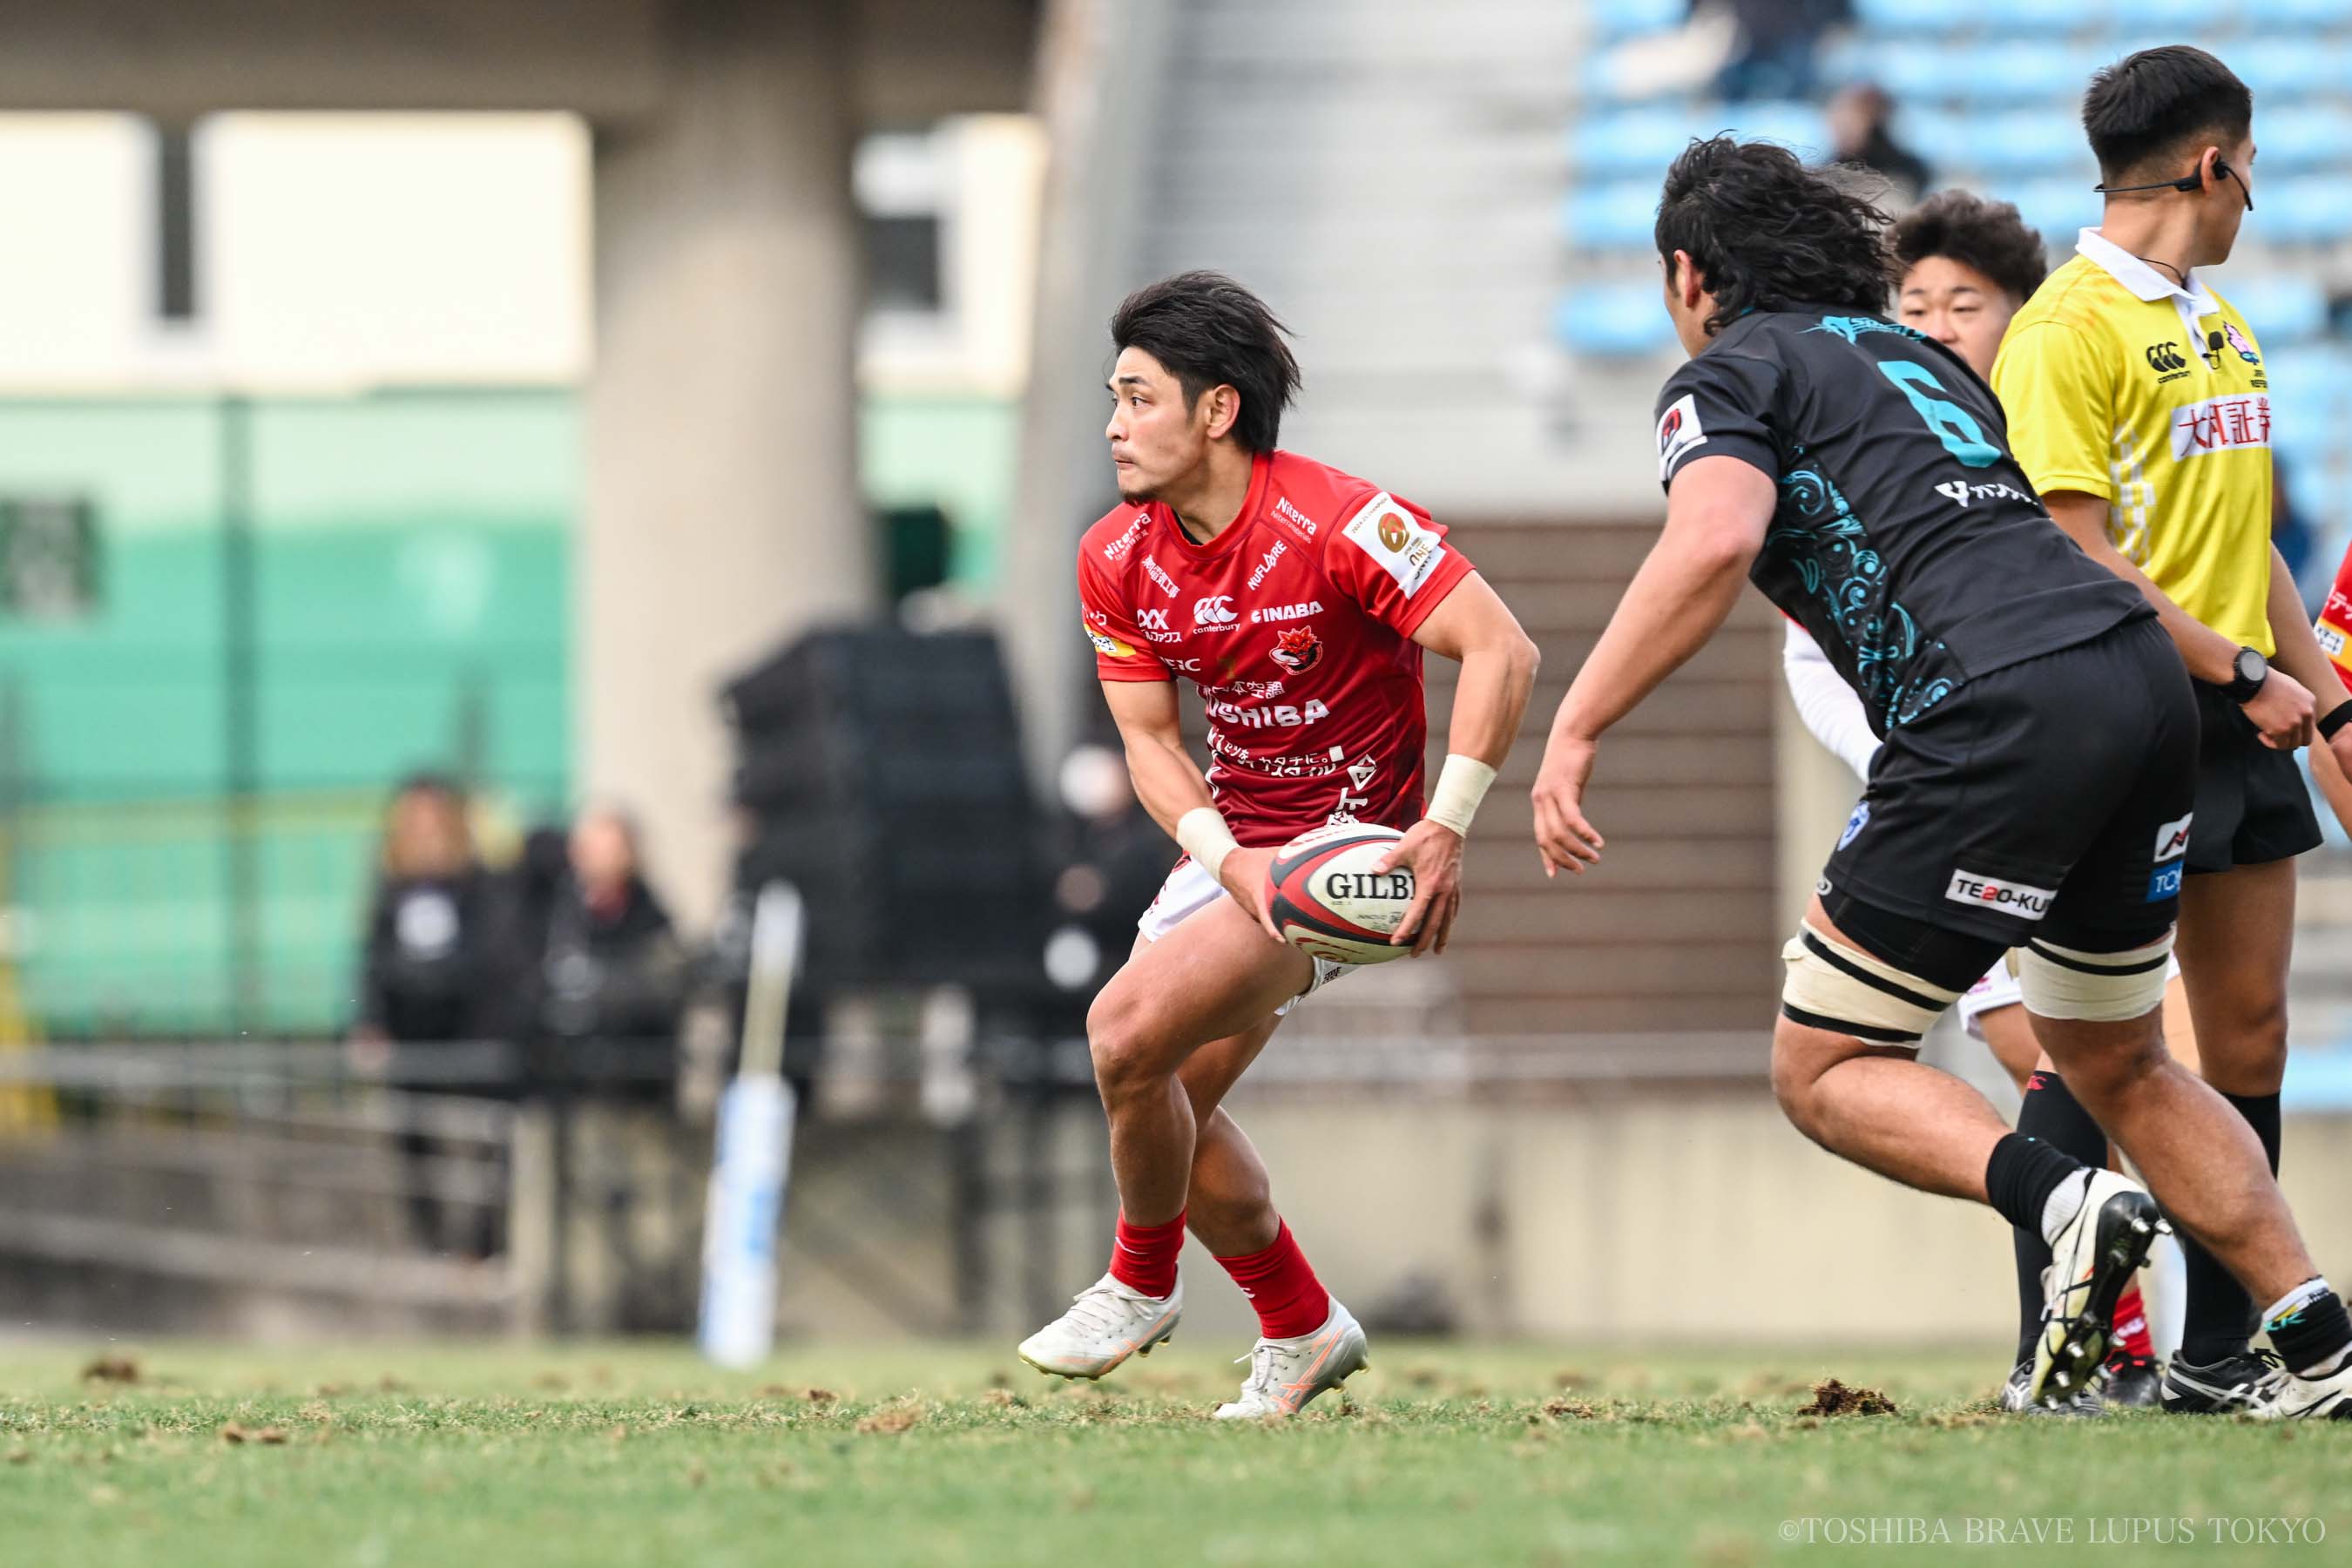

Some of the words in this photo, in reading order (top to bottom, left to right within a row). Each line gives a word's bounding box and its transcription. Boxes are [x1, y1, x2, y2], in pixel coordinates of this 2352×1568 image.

[1877, 360, 2002, 468] 6
[1276, 497, 1317, 536] Niterra
[1103, 512, 1152, 560] Niterra
[1263, 600, 1325, 623] INABA
[1140, 629, 1182, 643] ルファクス
[1193, 623, 1240, 635] canterbury
[1207, 698, 1330, 729] SHIBA
[1327, 873, 1415, 900] GILB
